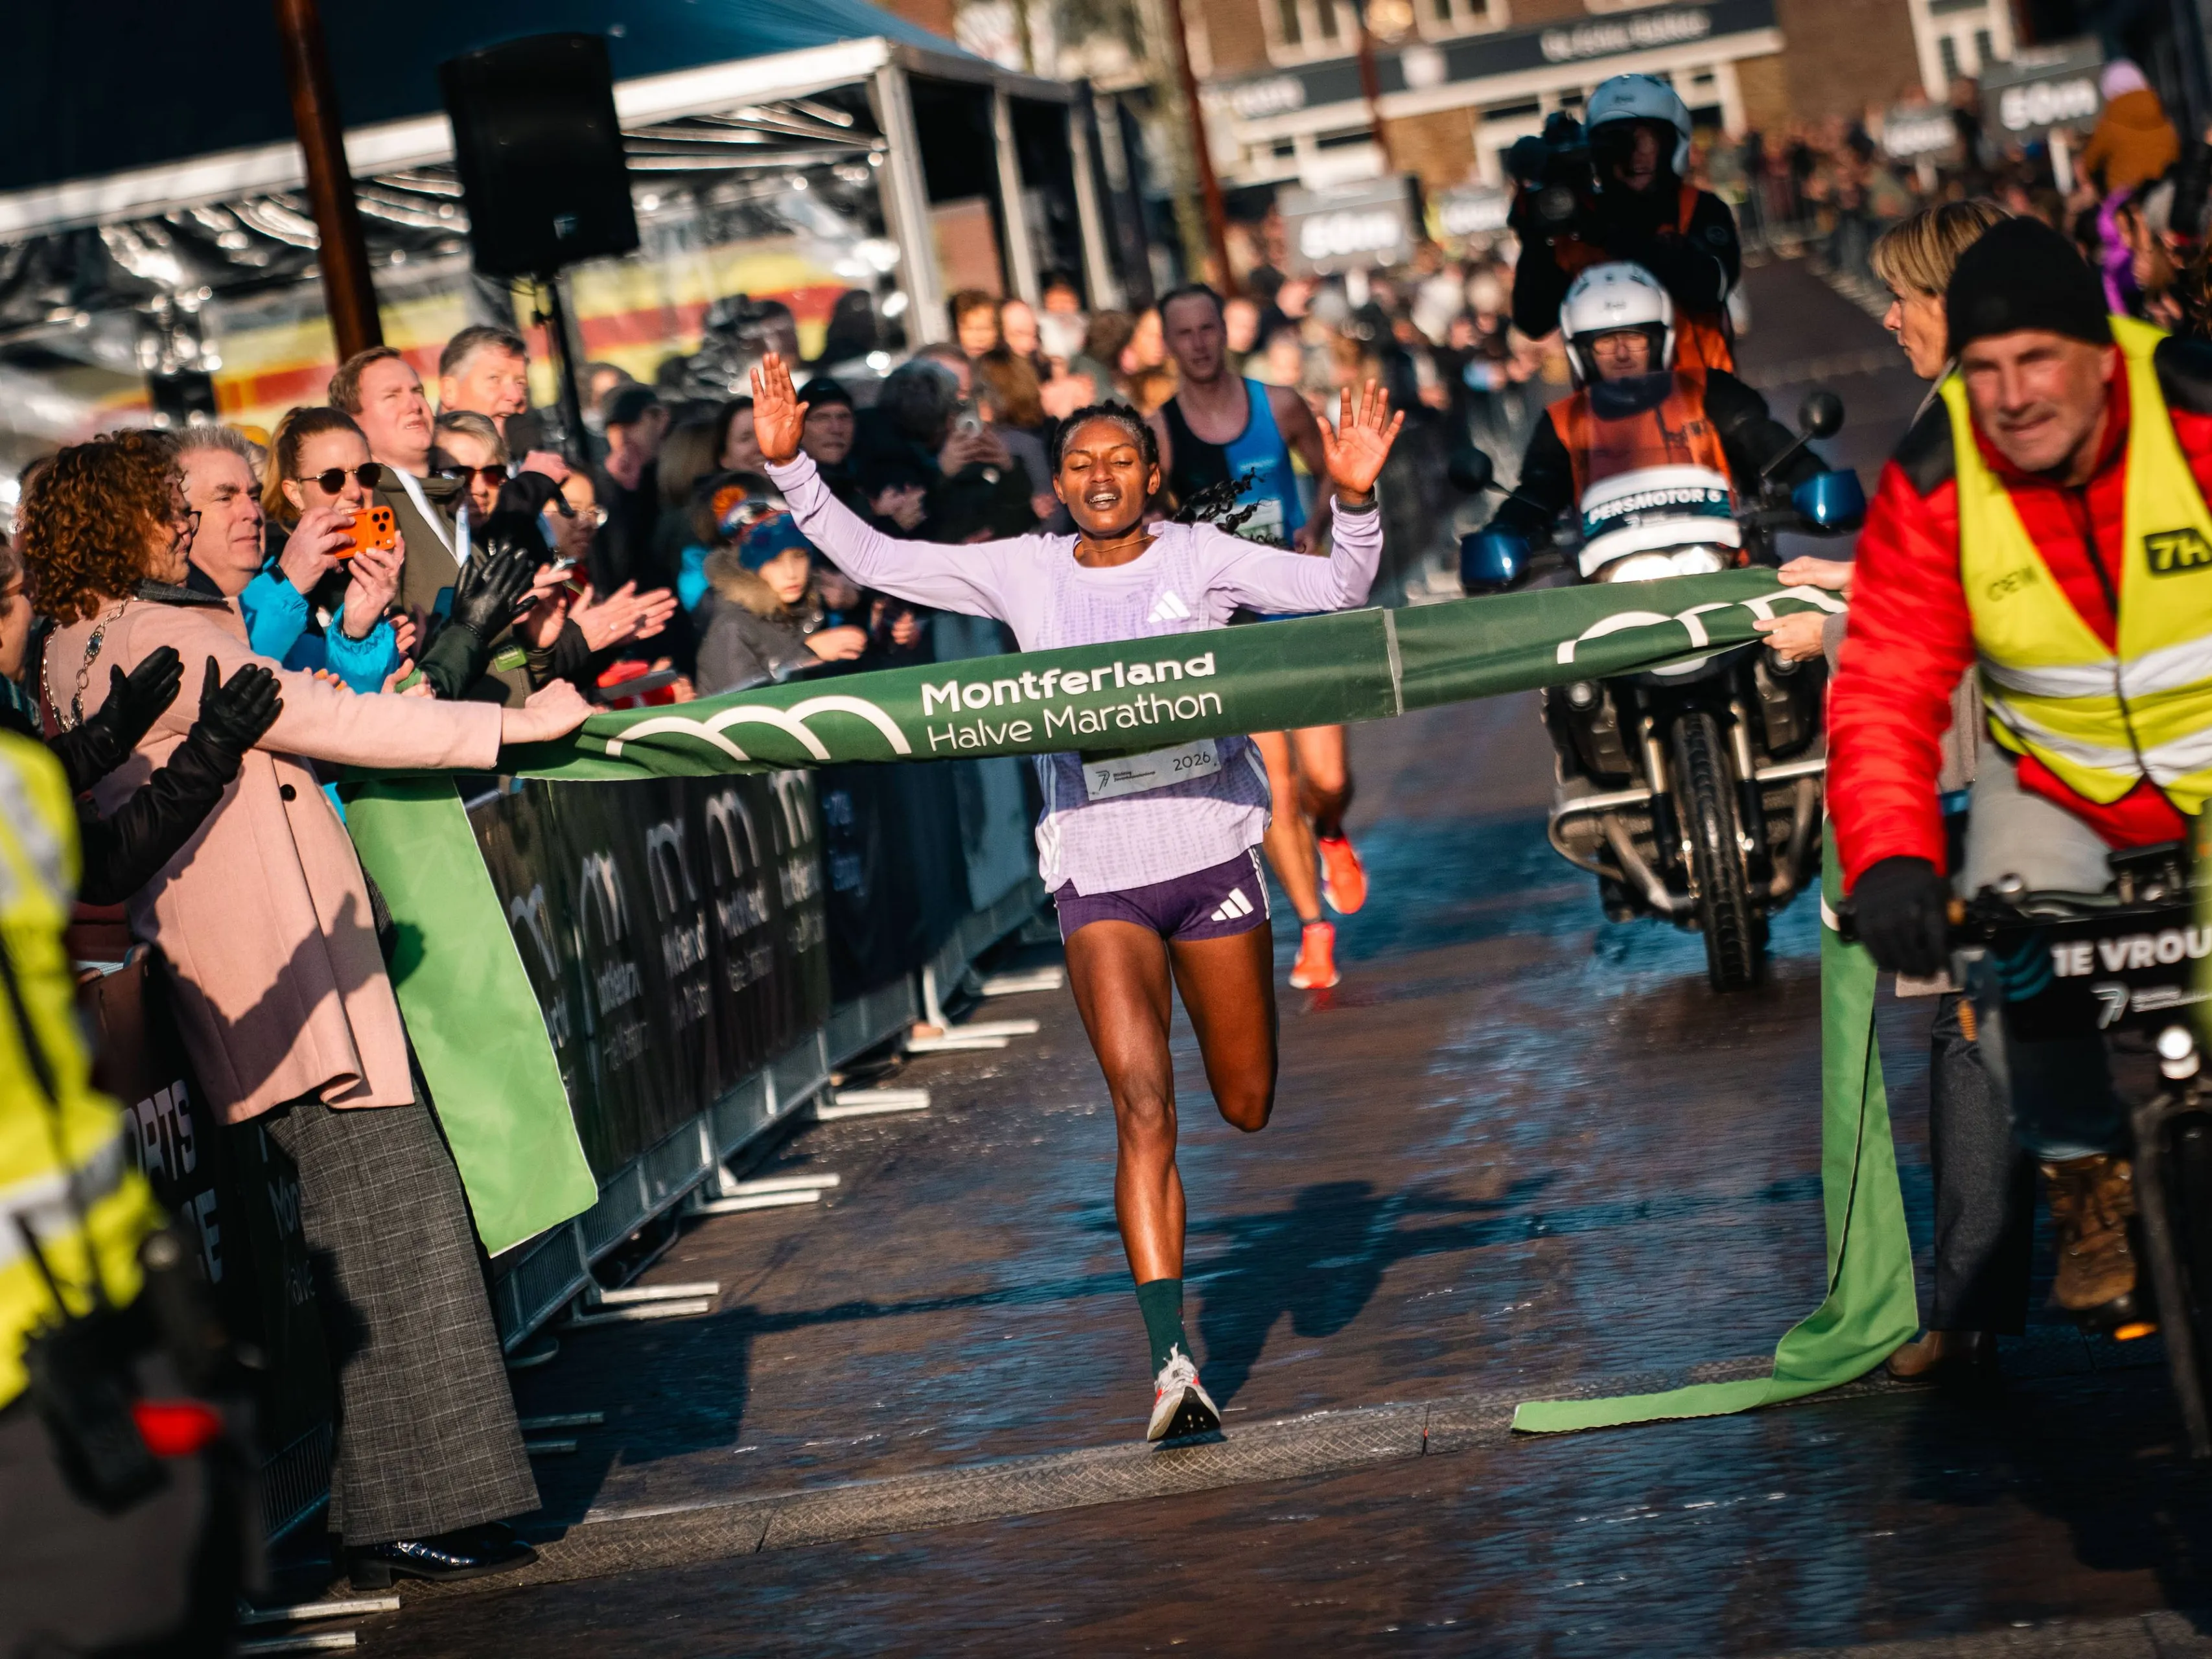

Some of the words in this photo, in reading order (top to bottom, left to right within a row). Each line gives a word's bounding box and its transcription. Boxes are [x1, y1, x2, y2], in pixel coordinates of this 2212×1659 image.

[1589, 488, 1705, 525] PERSMOTOR
[921, 652, 1216, 717] Montferland
[927, 718, 1033, 752] Halve
[1043, 691, 1222, 739] Marathon
[1172, 751, 1211, 772] 2026
